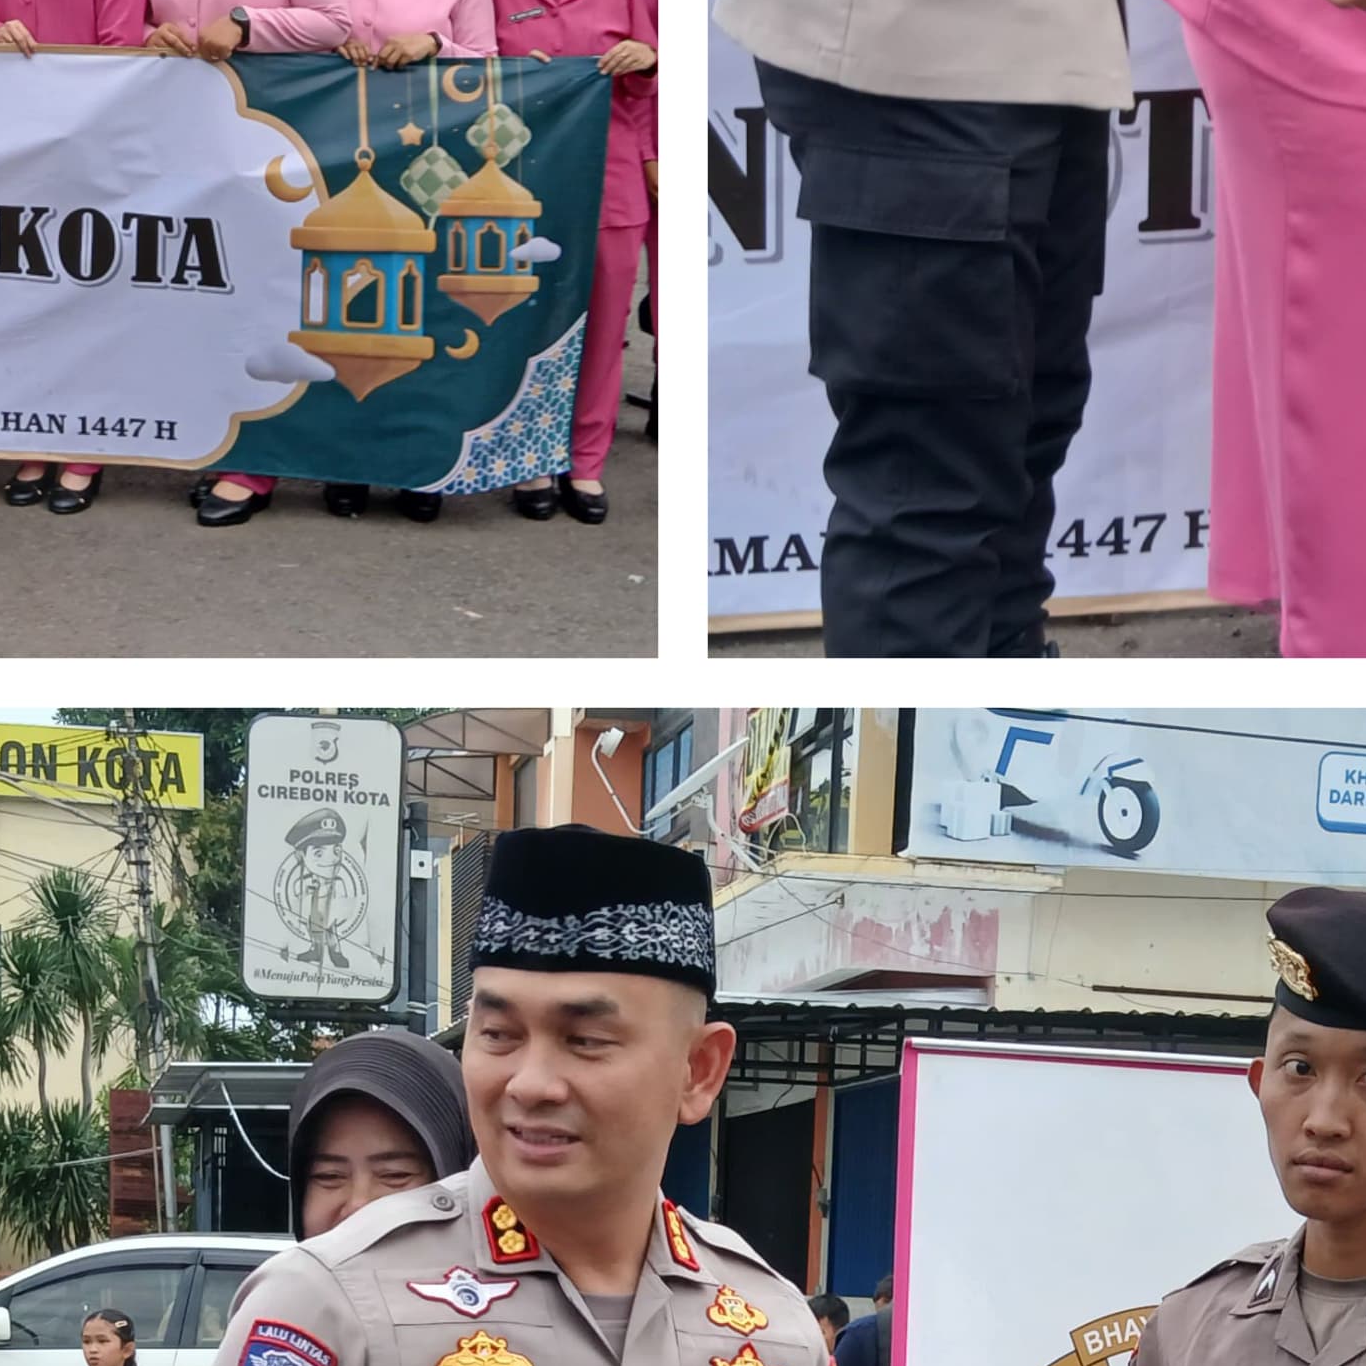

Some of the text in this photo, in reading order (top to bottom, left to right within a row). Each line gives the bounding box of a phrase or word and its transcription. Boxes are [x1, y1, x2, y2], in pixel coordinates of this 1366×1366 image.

[77, 416, 146, 438] 1447
[154, 420, 178, 441] H
[1045, 515, 1166, 558] 447
[76, 745, 187, 794] KOTA
[289, 769, 359, 786] POLRES
[257, 785, 390, 807] CIREBON KOTA
[259, 1326, 331, 1366] LALU LINTAS
